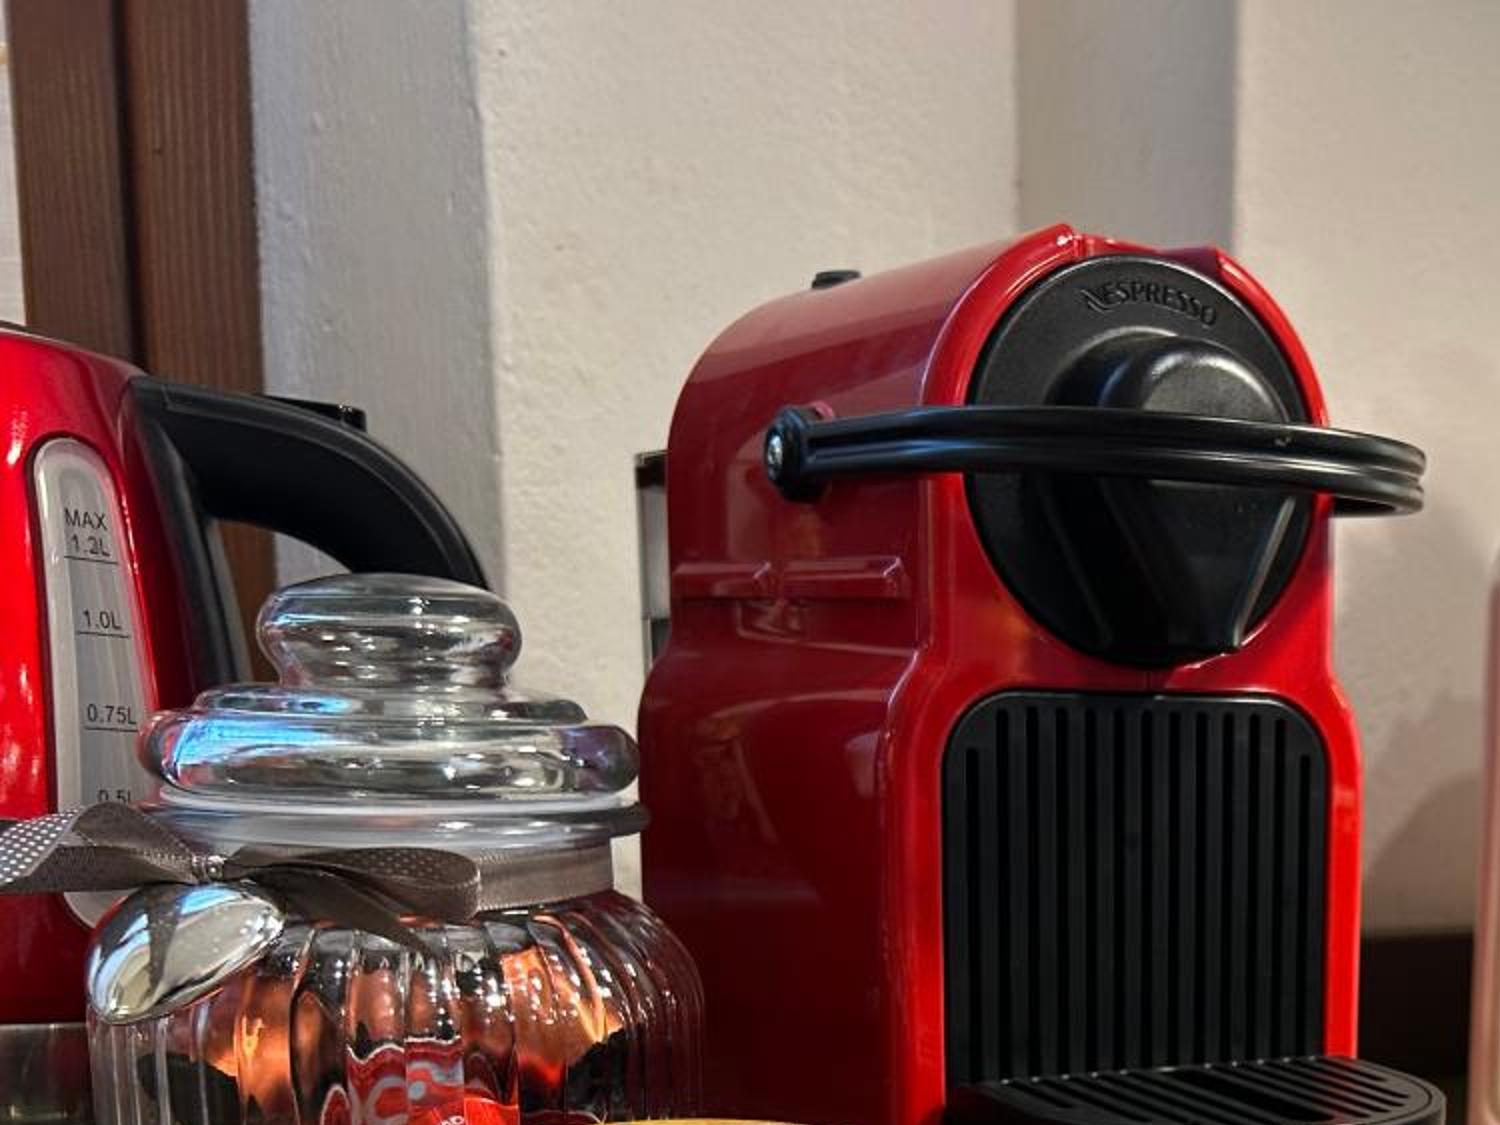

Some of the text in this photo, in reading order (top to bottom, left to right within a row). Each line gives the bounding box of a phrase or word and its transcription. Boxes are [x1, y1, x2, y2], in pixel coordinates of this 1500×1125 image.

[1080, 281, 1217, 327] NESPRESSO
[64, 508, 108, 531] MAX
[70, 534, 111, 558] 1.2L
[82, 609, 122, 631] 1.0L
[87, 703, 137, 726] 0.75L
